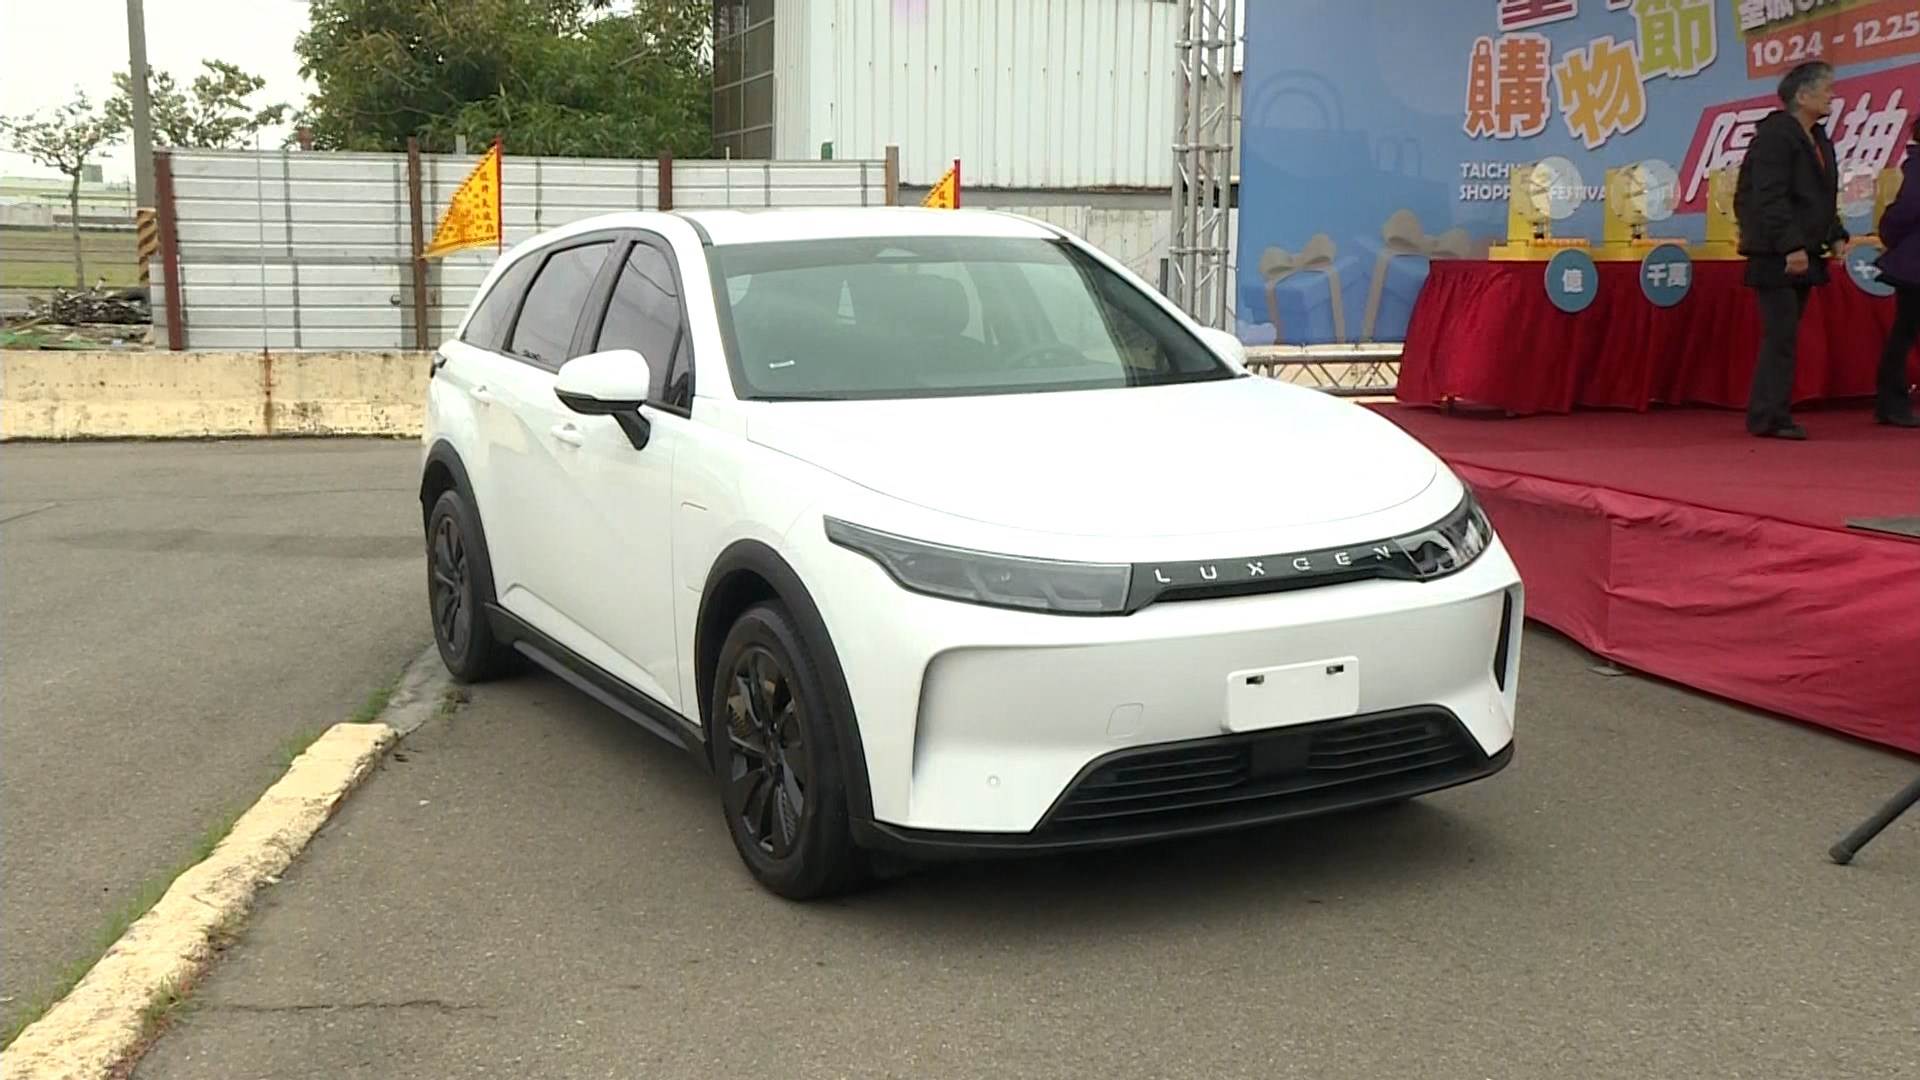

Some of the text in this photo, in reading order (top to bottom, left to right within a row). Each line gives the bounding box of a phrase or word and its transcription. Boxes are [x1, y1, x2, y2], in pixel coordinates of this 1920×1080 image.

[1752, 31, 1824, 67] 10.24
[1852, 11, 1920, 48] 12.25
[1155, 546, 1392, 583] LUXGEN
